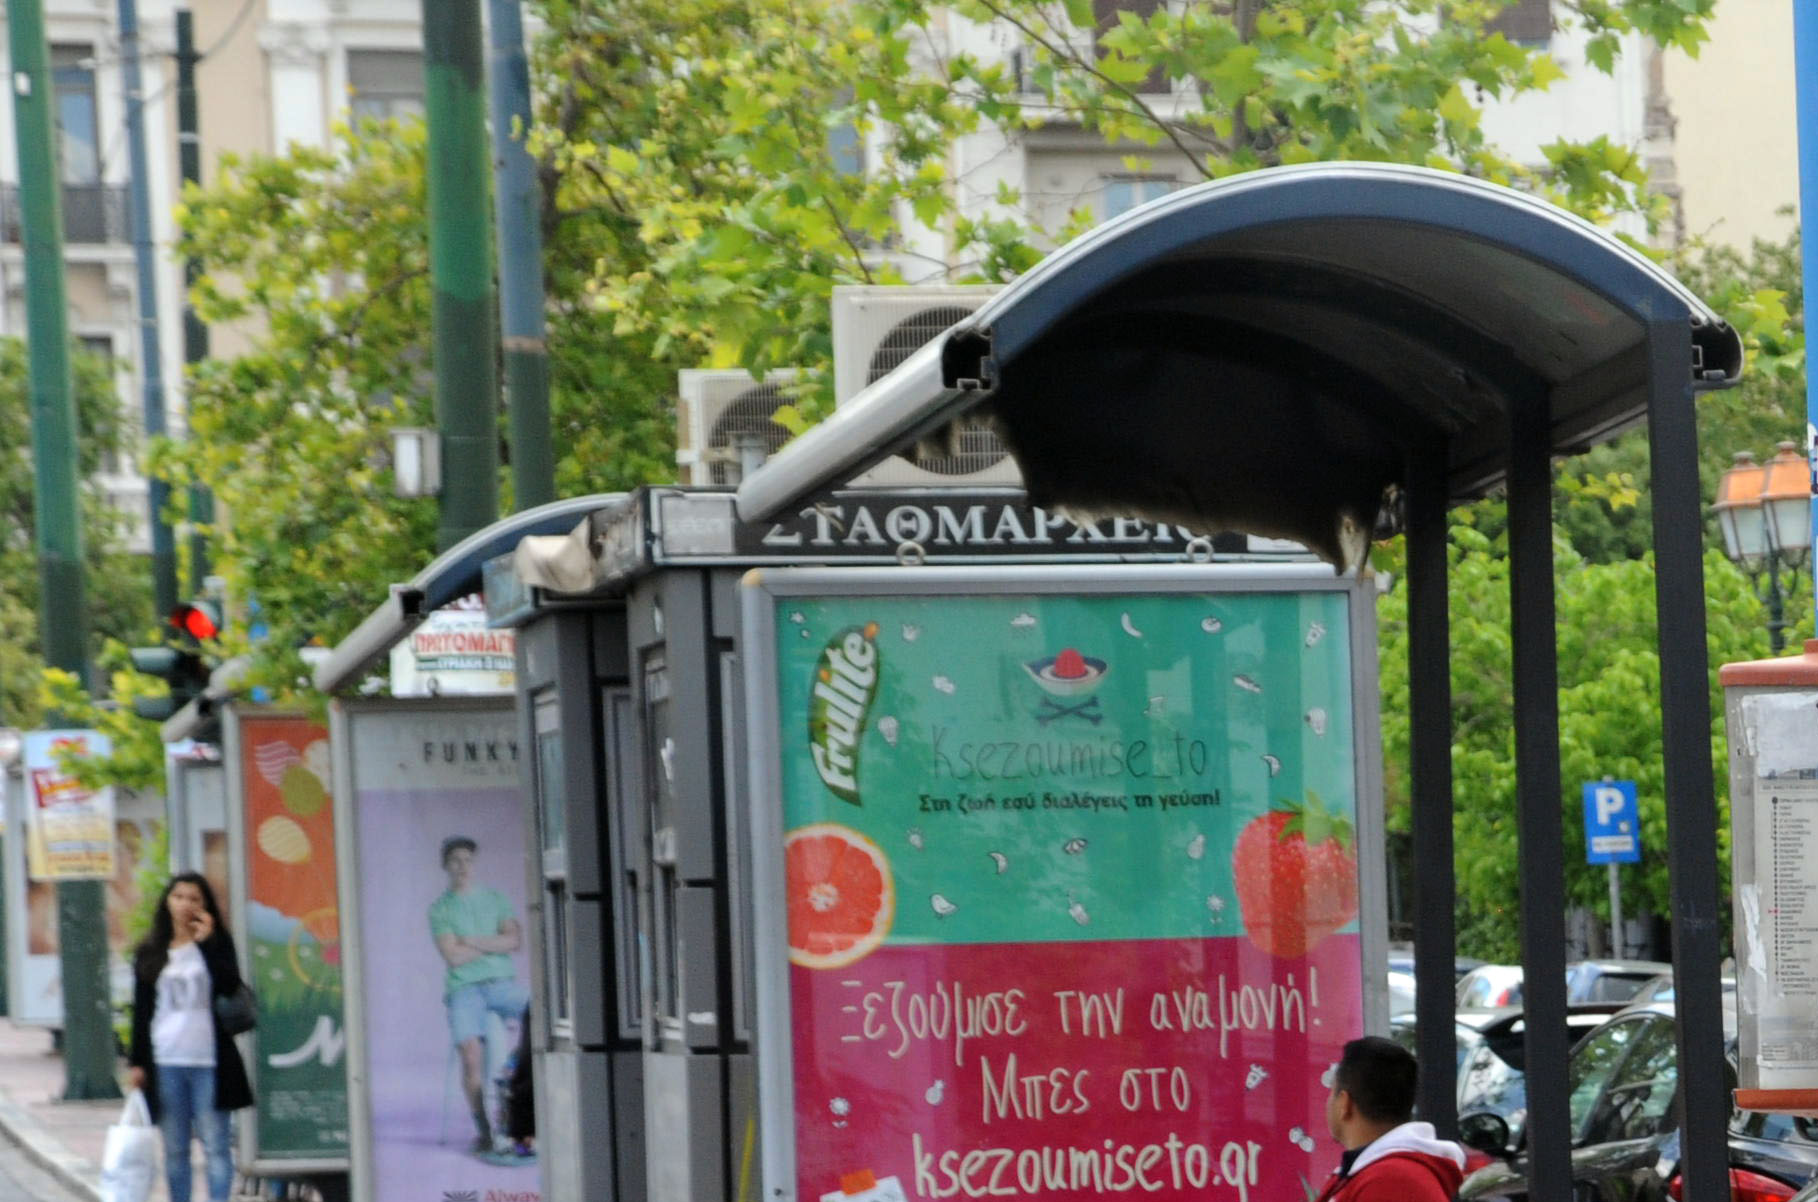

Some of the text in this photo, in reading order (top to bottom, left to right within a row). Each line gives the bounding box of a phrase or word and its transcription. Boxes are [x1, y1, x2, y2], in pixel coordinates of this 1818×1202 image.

[810, 631, 878, 791] Frulite
[423, 741, 519, 763] FUNKY
[919, 788, 1220, 815] Στη ζωή εσύ διαλέγεις τη γεύση!
[1596, 787, 1625, 826] P
[840, 966, 1322, 1066] Ξεζούμισε την αναμονή!
[980, 1052, 1191, 1124] Μπες στο
